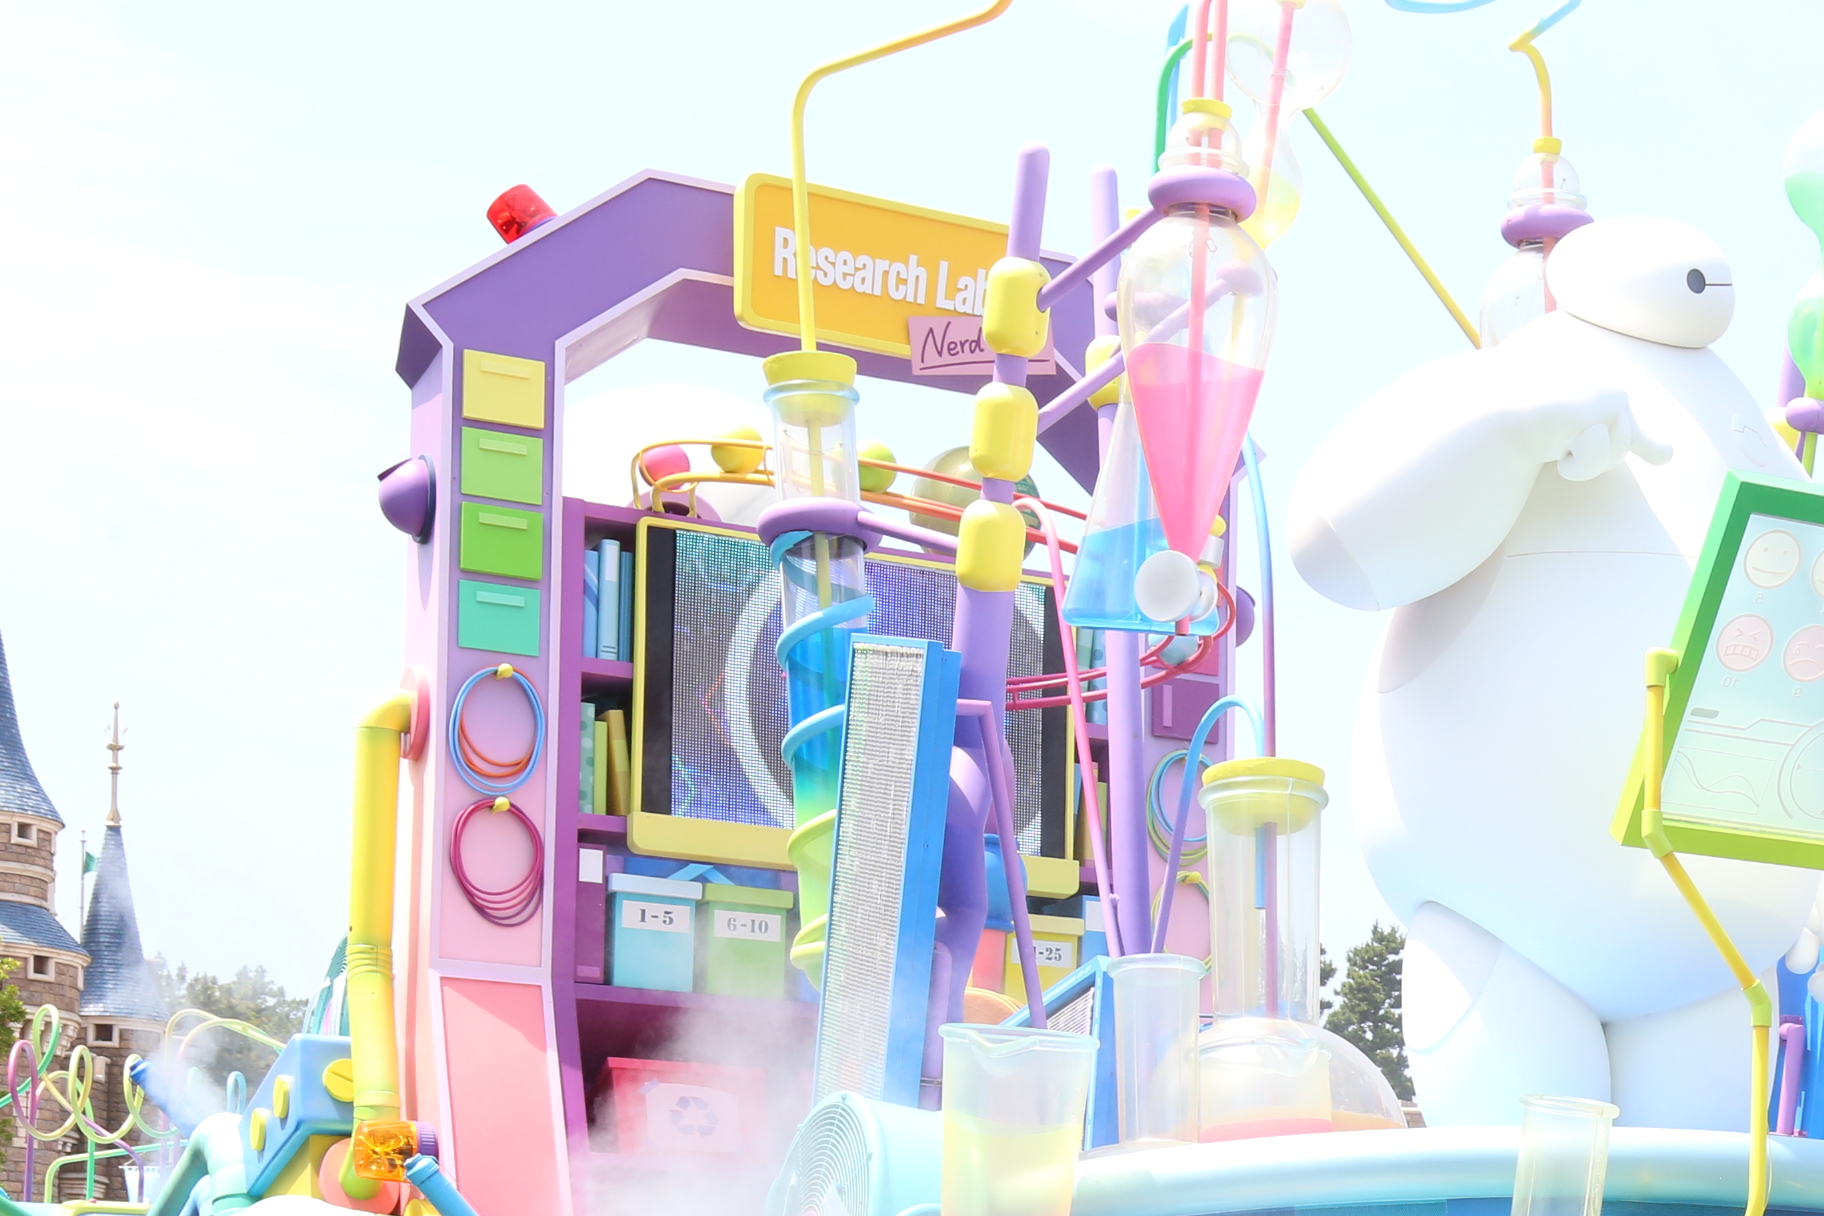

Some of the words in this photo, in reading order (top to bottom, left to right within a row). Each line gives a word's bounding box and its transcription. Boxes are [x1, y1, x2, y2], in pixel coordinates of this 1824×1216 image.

[921, 321, 985, 364] Nerd
[638, 908, 674, 926] 1-5
[726, 917, 769, 934] 6-10
